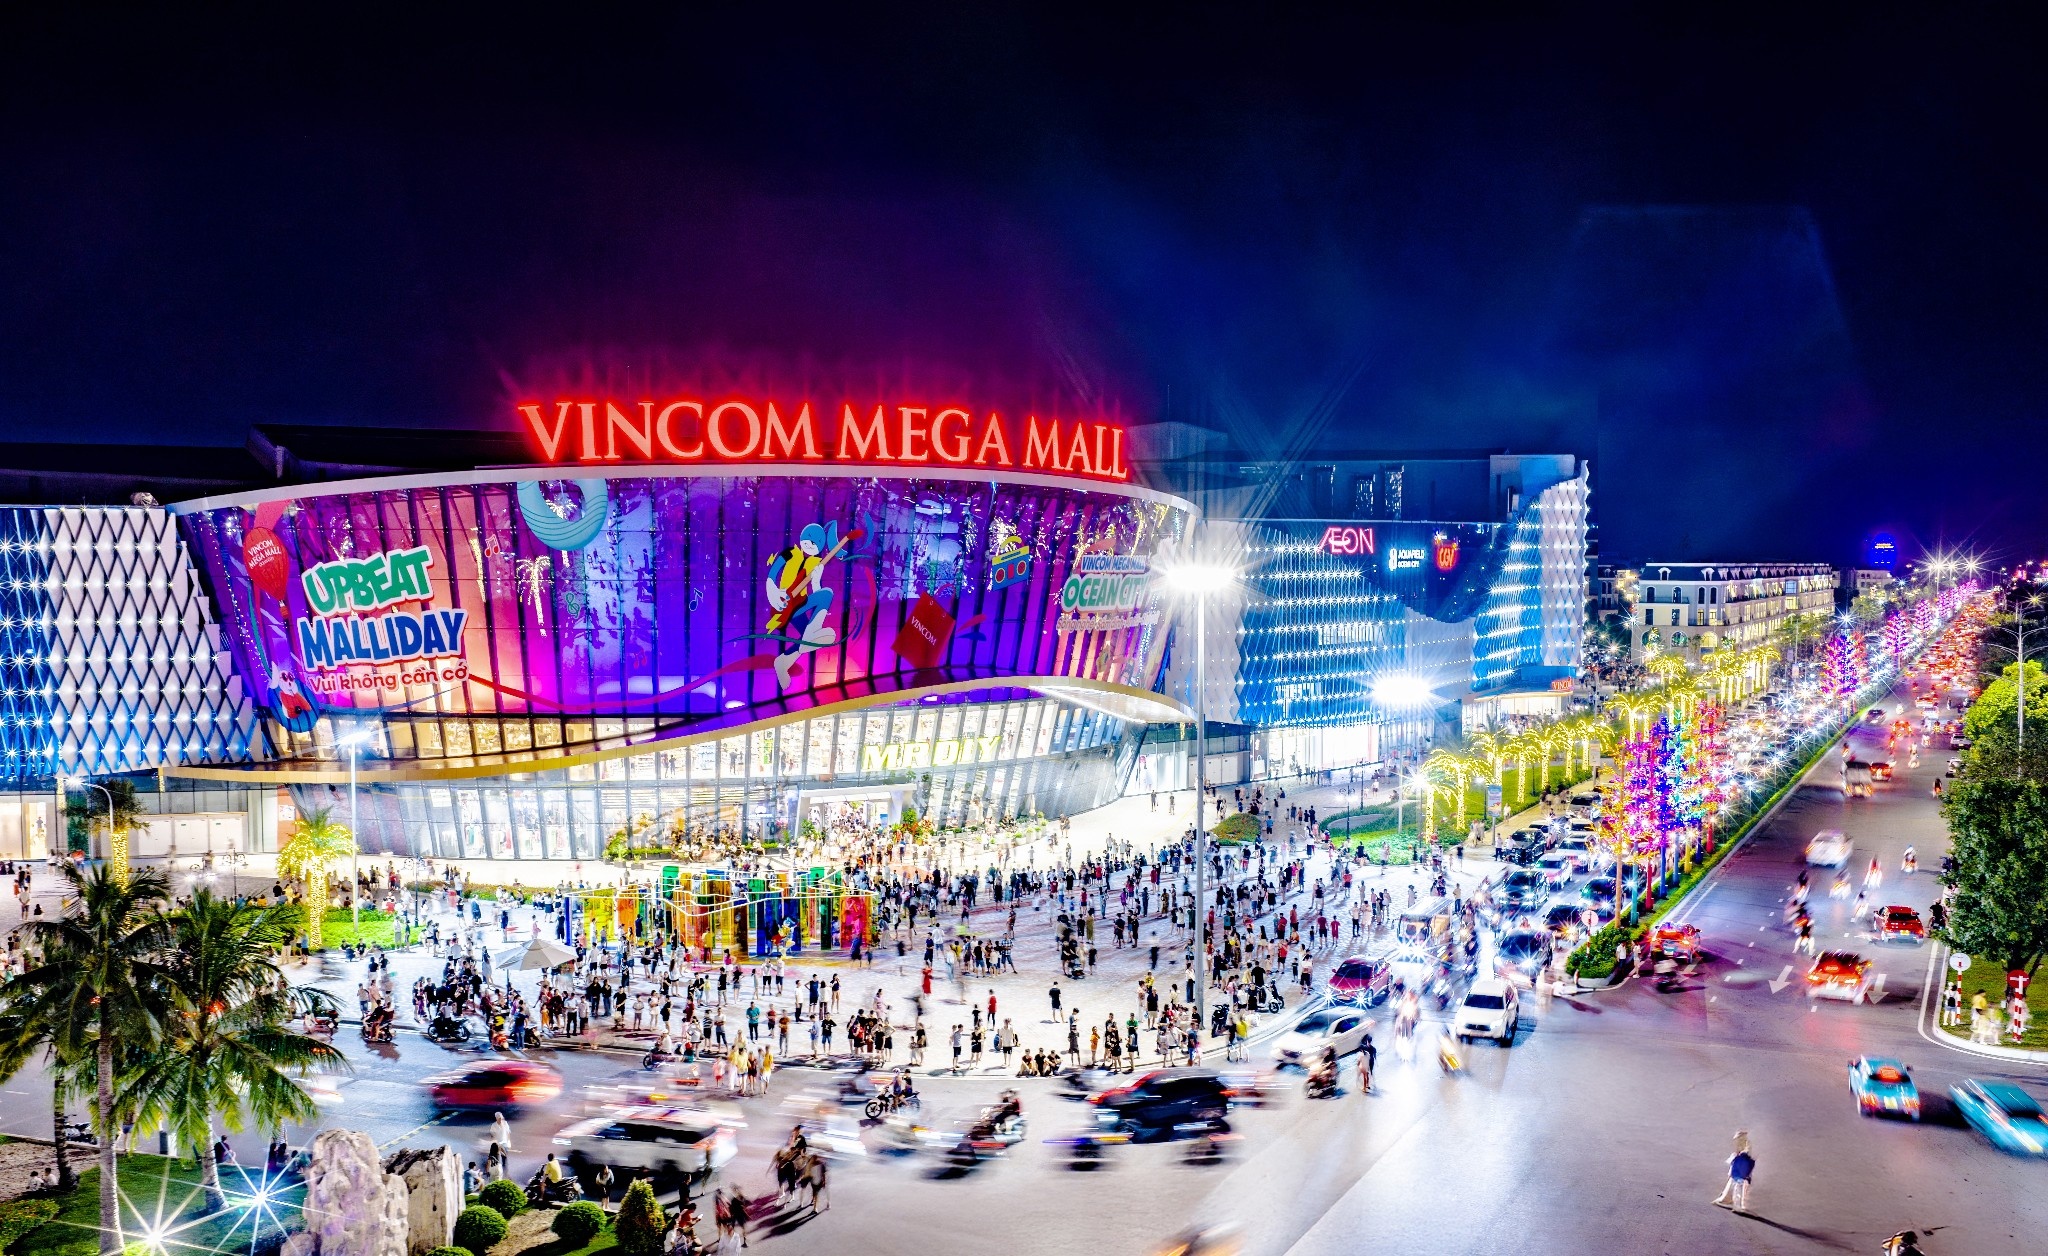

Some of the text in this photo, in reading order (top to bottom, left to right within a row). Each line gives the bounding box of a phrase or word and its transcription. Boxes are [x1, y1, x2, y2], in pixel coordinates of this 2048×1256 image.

[518, 401, 1127, 478] VINCOM MEGA MALL
[248, 539, 274, 556] VINCOM
[248, 552, 266, 570] MEGA
[264, 546, 282, 558] MALL
[1439, 547, 1455, 567] CGV
[1083, 556, 1111, 571] VINCOM
[1112, 556, 1130, 571] MEGA
[303, 548, 432, 614] UPBEAT
[1063, 577, 1119, 608] OCEAN
[299, 610, 465, 669] MALLIDAY
[911, 615, 937, 646] VINCOM
[310, 677, 337, 693] Vui
[339, 673, 397, 691] không
[401, 666, 439, 686] cần
